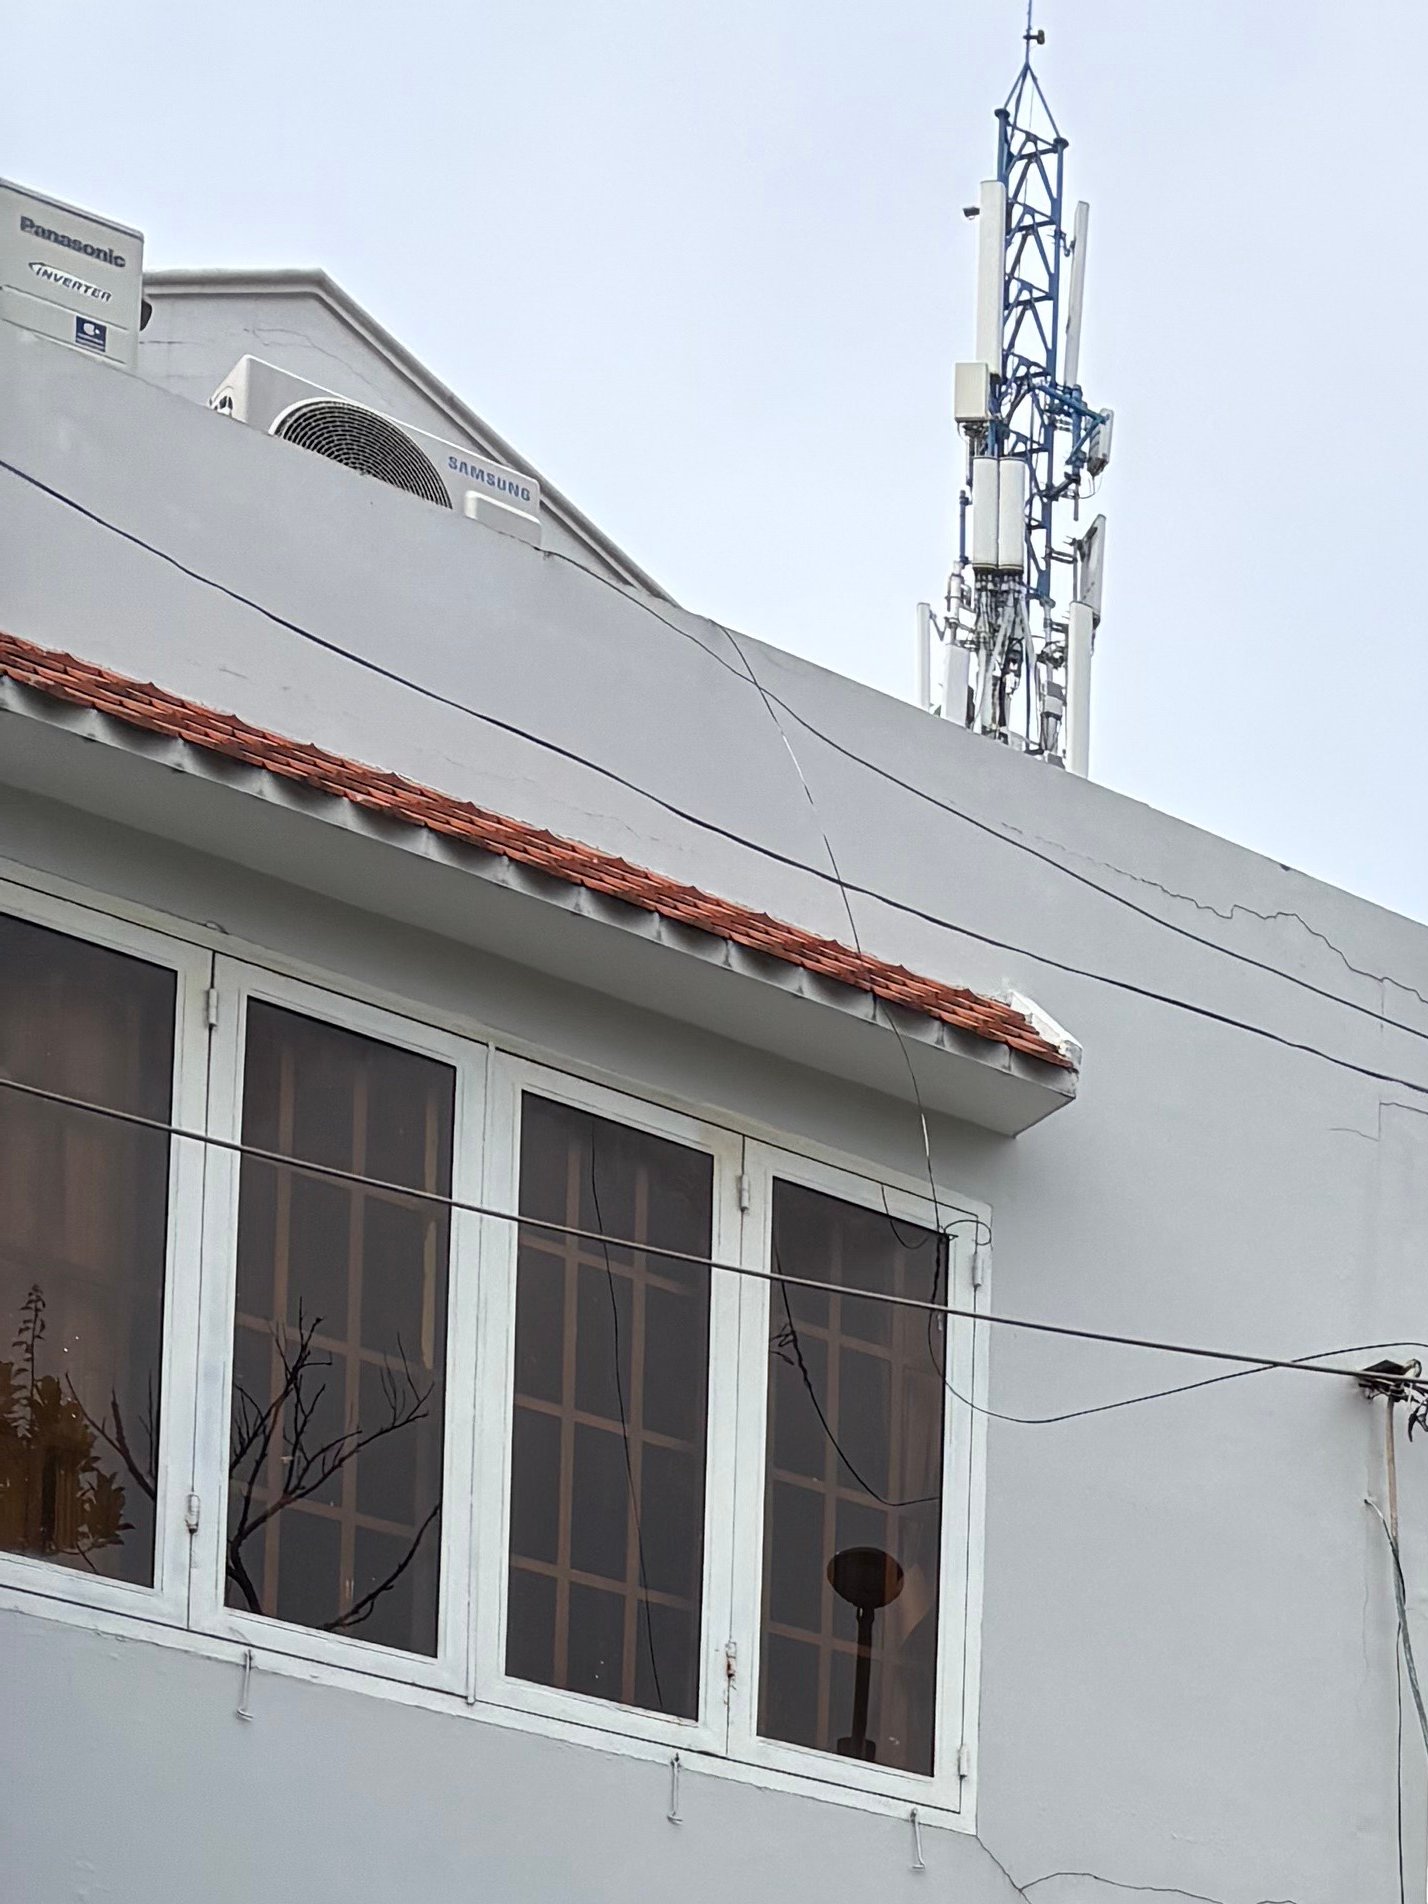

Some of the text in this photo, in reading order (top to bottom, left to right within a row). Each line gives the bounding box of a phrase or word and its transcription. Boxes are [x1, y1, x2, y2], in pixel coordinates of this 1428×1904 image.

[20, 215, 126, 268] Panasonic
[35, 266, 112, 302] INVERTER
[448, 456, 530, 501] SAMSUNG
